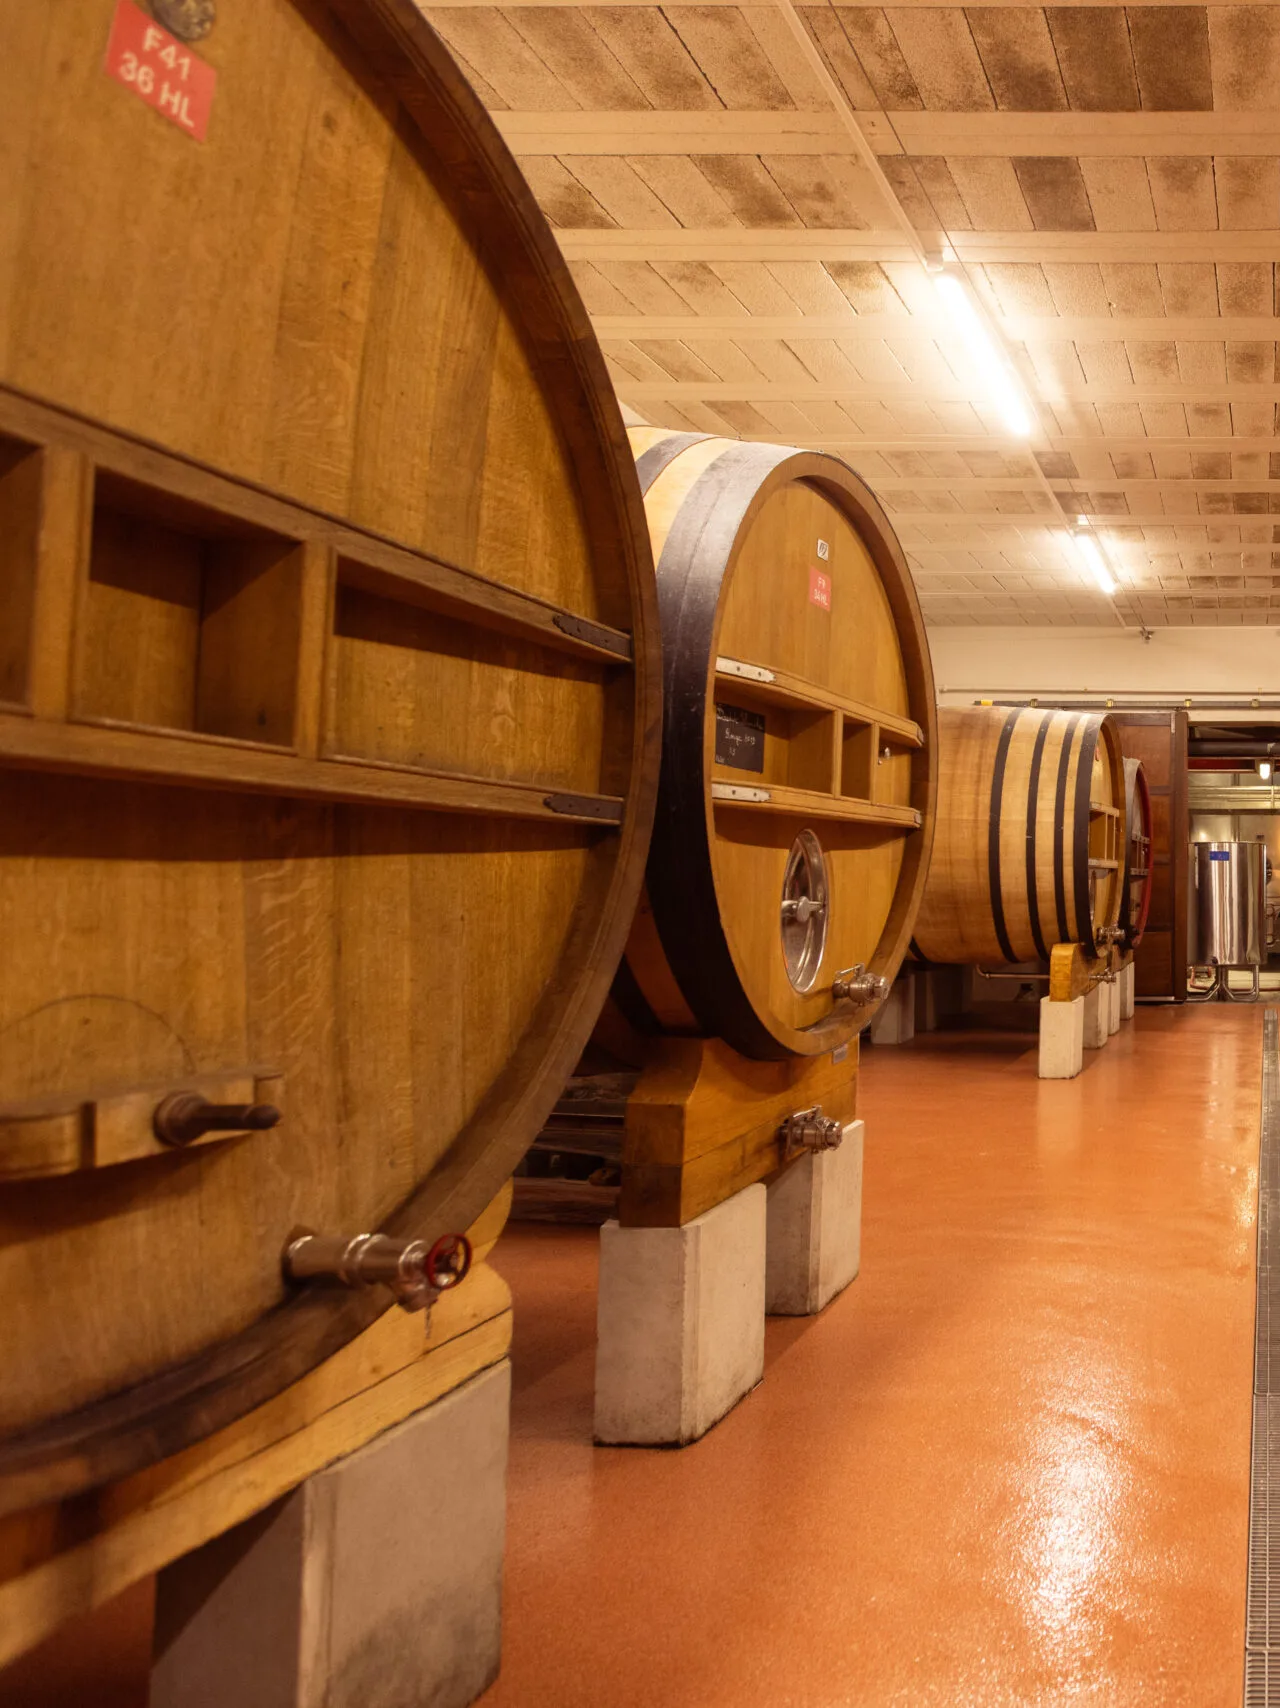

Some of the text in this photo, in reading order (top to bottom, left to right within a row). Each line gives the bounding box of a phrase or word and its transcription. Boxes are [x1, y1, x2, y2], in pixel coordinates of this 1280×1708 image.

[142, 26, 191, 82] F41
[119, 51, 195, 128] 36 HL
